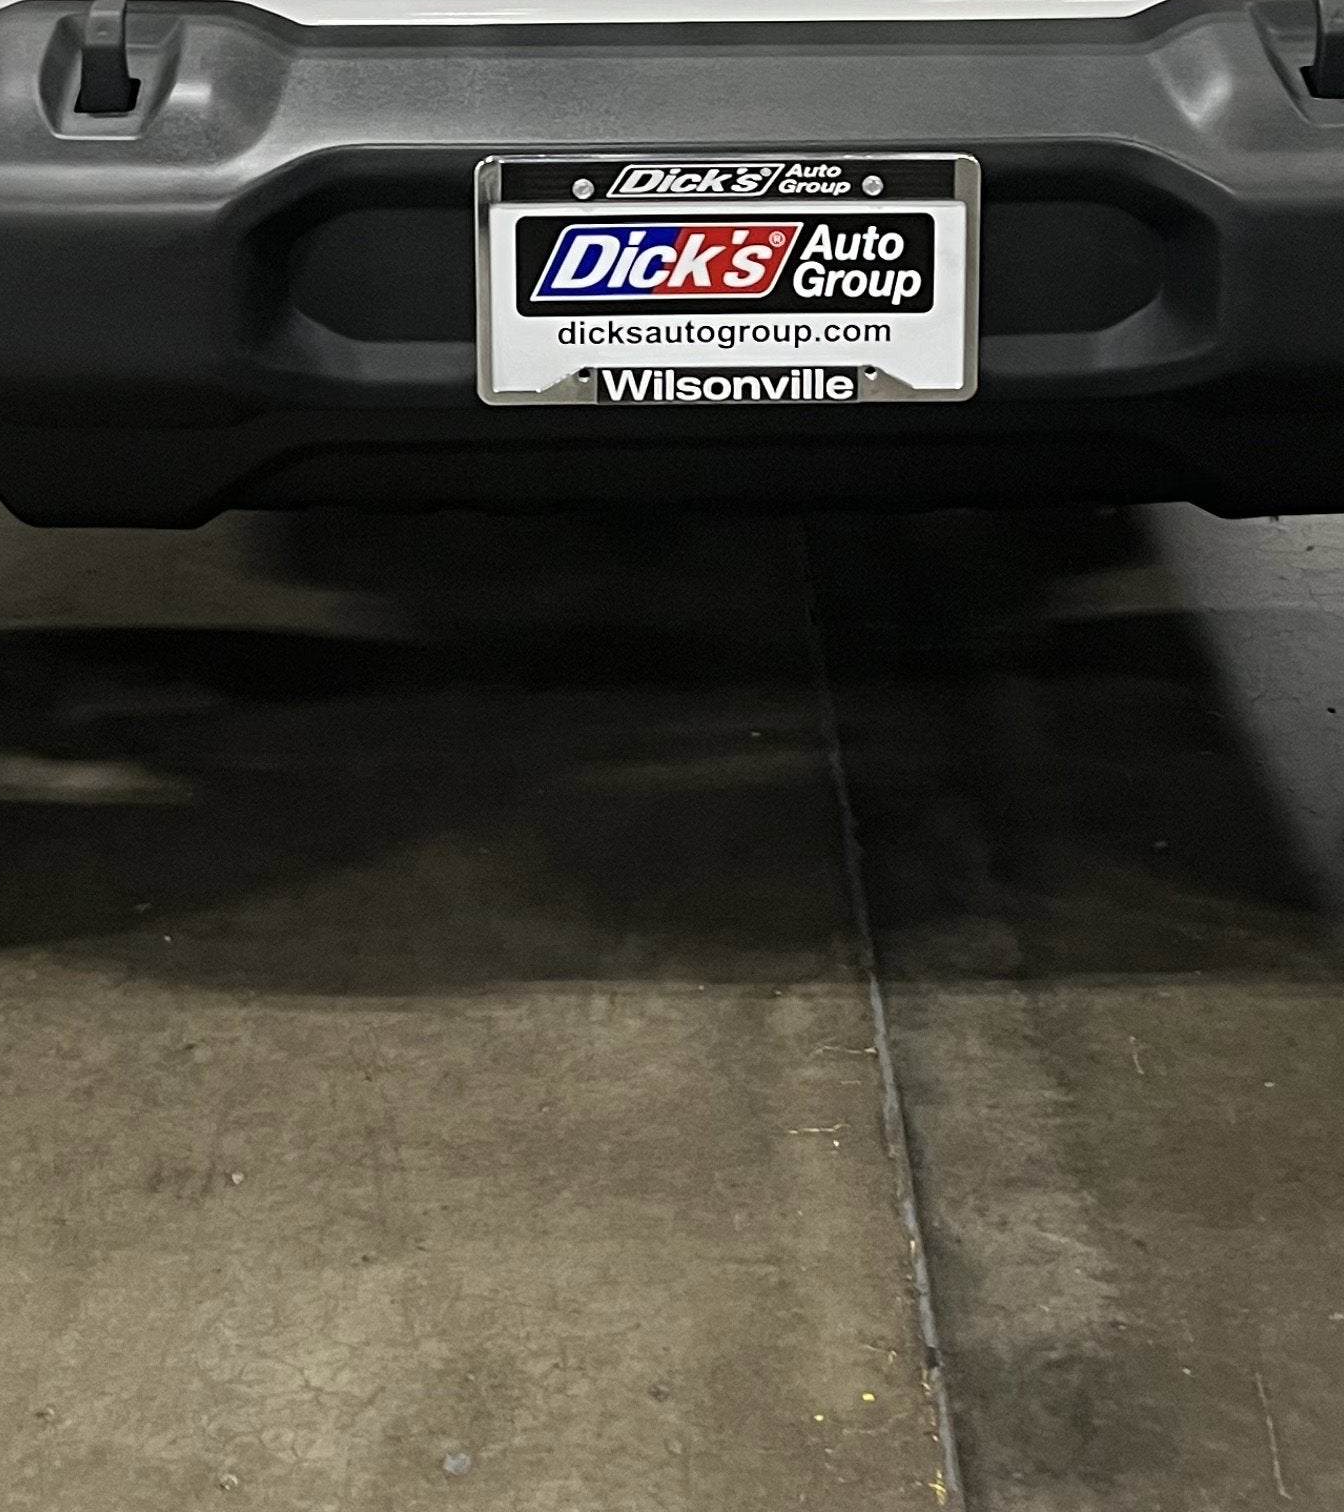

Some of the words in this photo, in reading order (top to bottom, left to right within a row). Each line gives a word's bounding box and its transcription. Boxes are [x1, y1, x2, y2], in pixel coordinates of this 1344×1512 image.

[619, 168, 762, 193] Dick's
[785, 164, 842, 177] Auto
[779, 179, 851, 196] Group
[800, 225, 904, 261] Auto
[551, 230, 769, 289] Dick's
[793, 262, 922, 305] Group
[558, 322, 891, 348] dicksautogroup.com
[602, 370, 854, 401] Wilsonville
